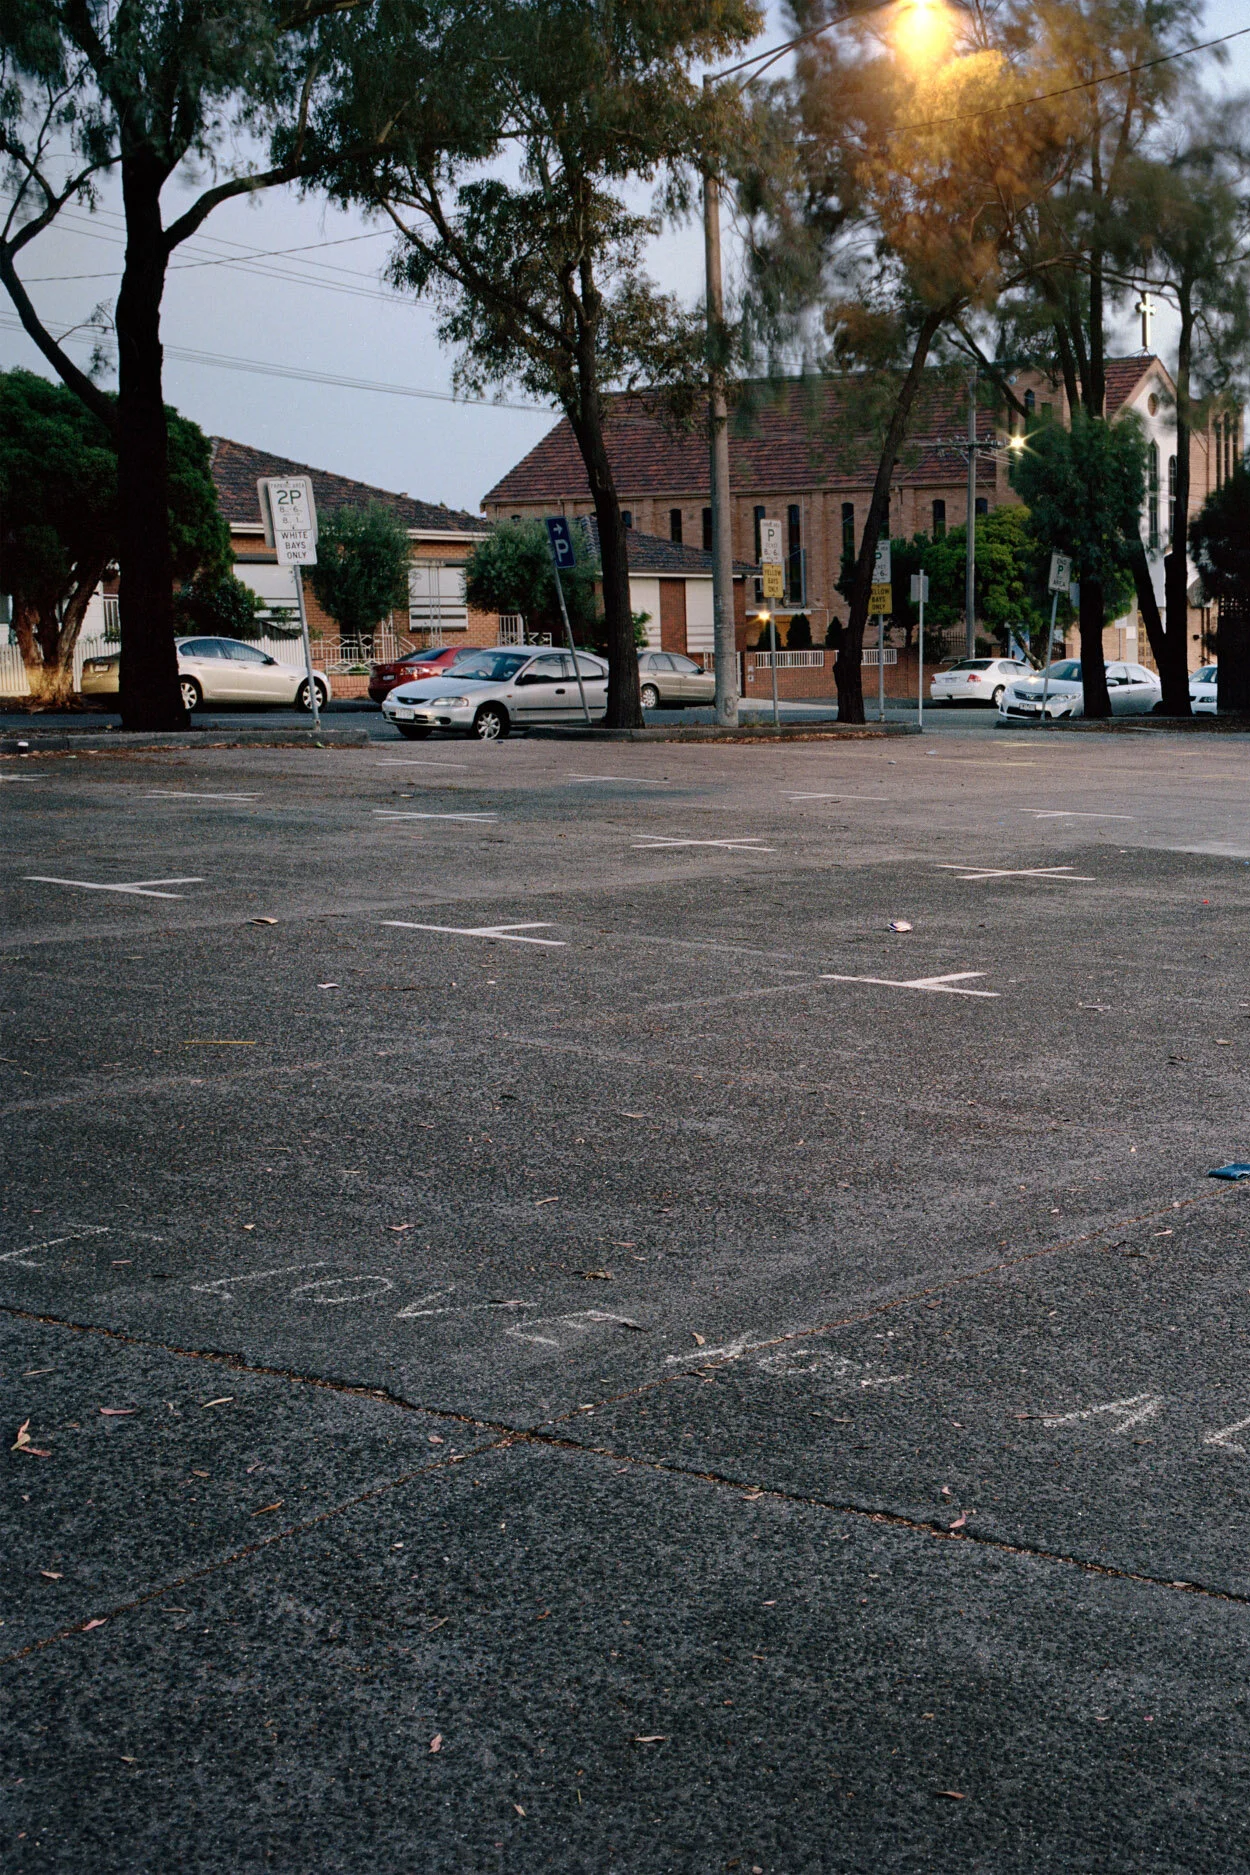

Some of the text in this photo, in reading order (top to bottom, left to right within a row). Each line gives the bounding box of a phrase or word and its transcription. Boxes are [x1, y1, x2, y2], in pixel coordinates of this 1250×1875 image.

[276, 490, 301, 504] 2P
[281, 531, 308, 539] WHITE
[768, 529, 775, 541] P
[285, 541, 306, 549] BAYS
[287, 551, 307, 559] ONLY
[554, 539, 569, 562] P
[1058, 565, 1064, 574] P
[190, 1260, 642, 1347] LOVE
